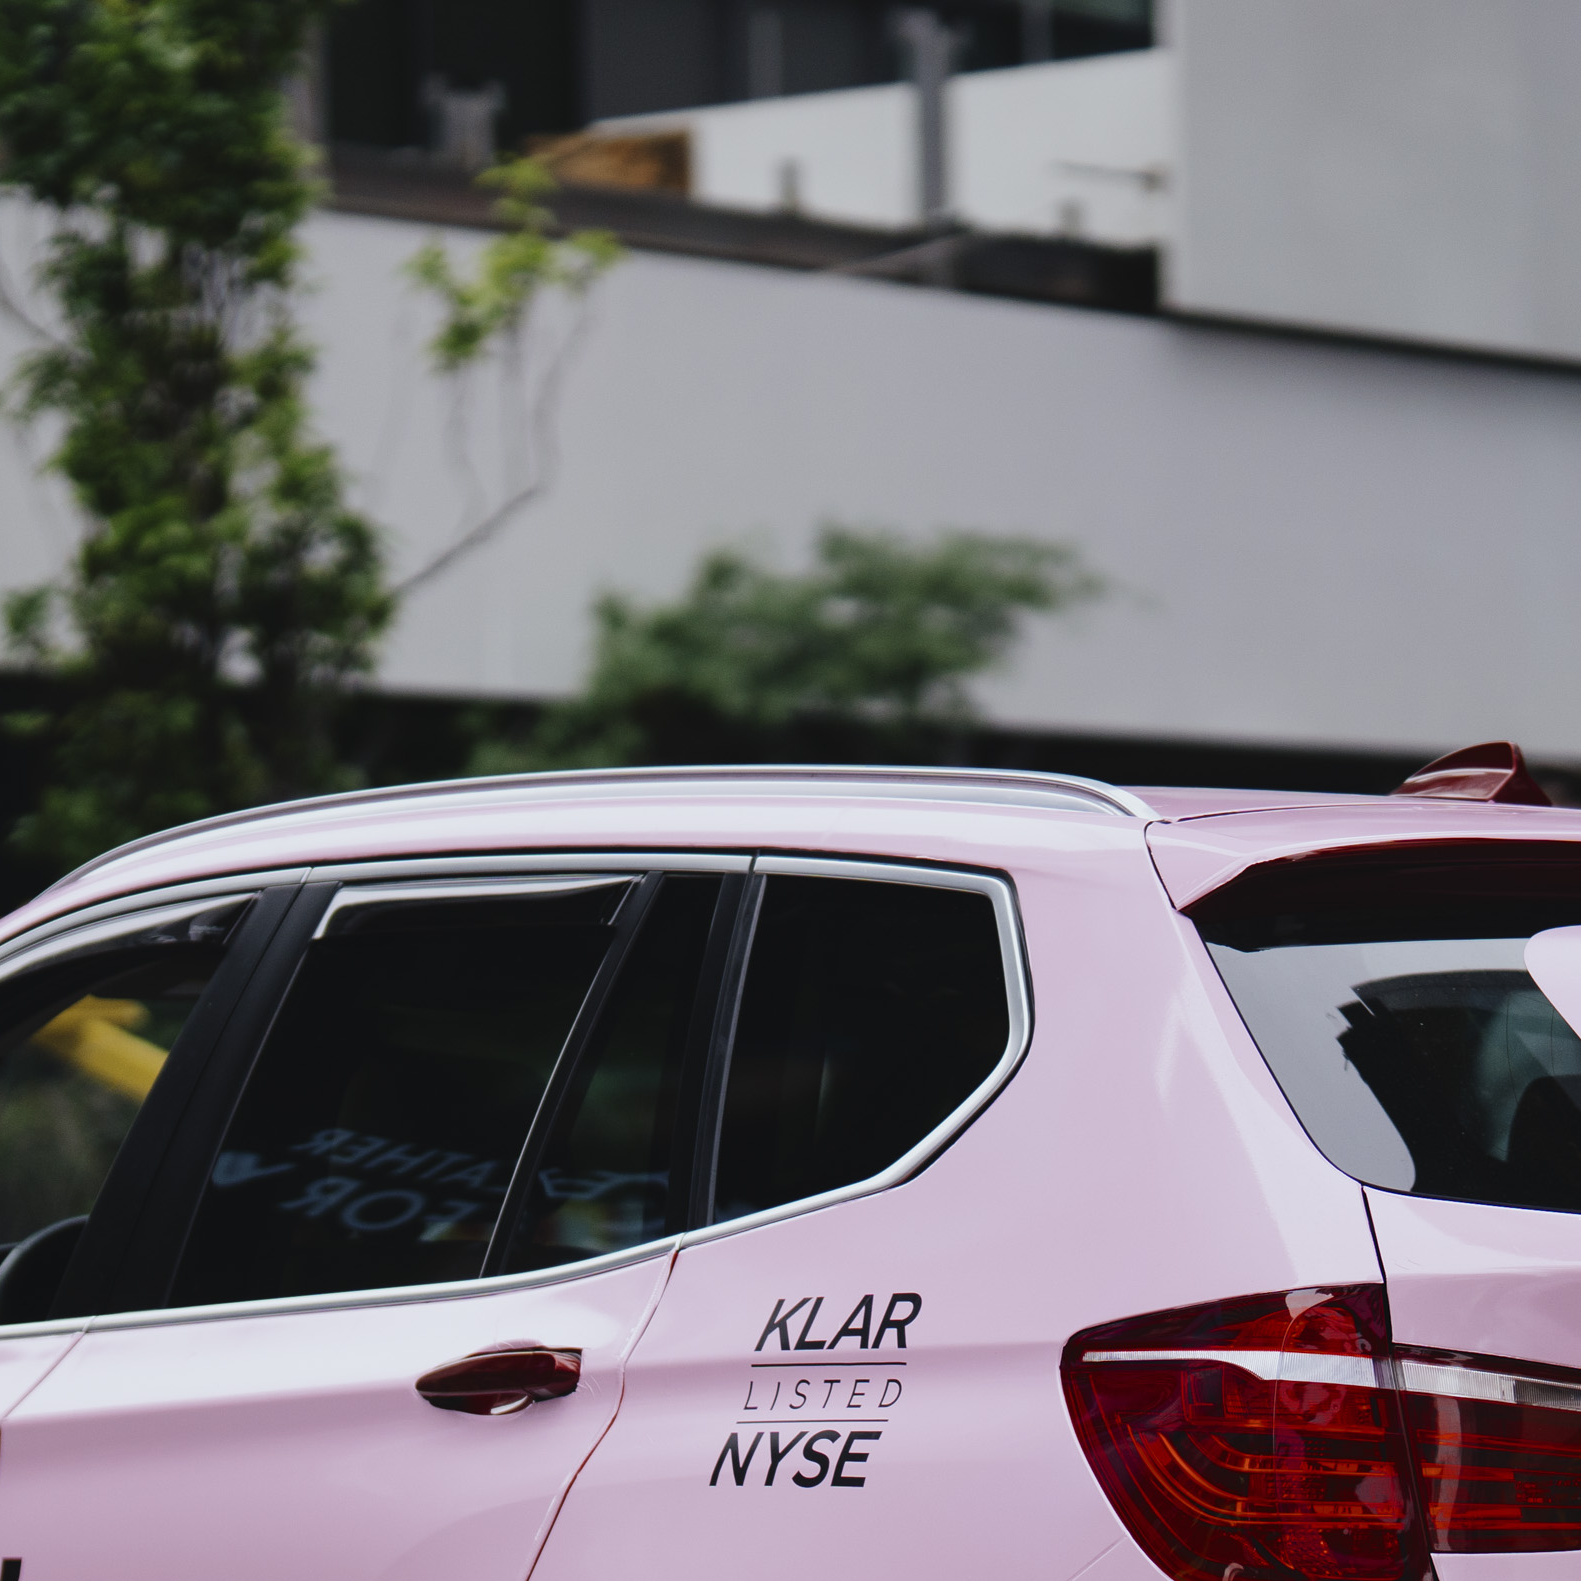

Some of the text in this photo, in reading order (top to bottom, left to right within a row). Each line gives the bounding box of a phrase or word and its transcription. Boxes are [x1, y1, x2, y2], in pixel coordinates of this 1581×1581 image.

[753, 1292, 923, 1352] KLAR
[743, 1378, 903, 1411] LISTED
[708, 1429, 883, 1489] NYSE
